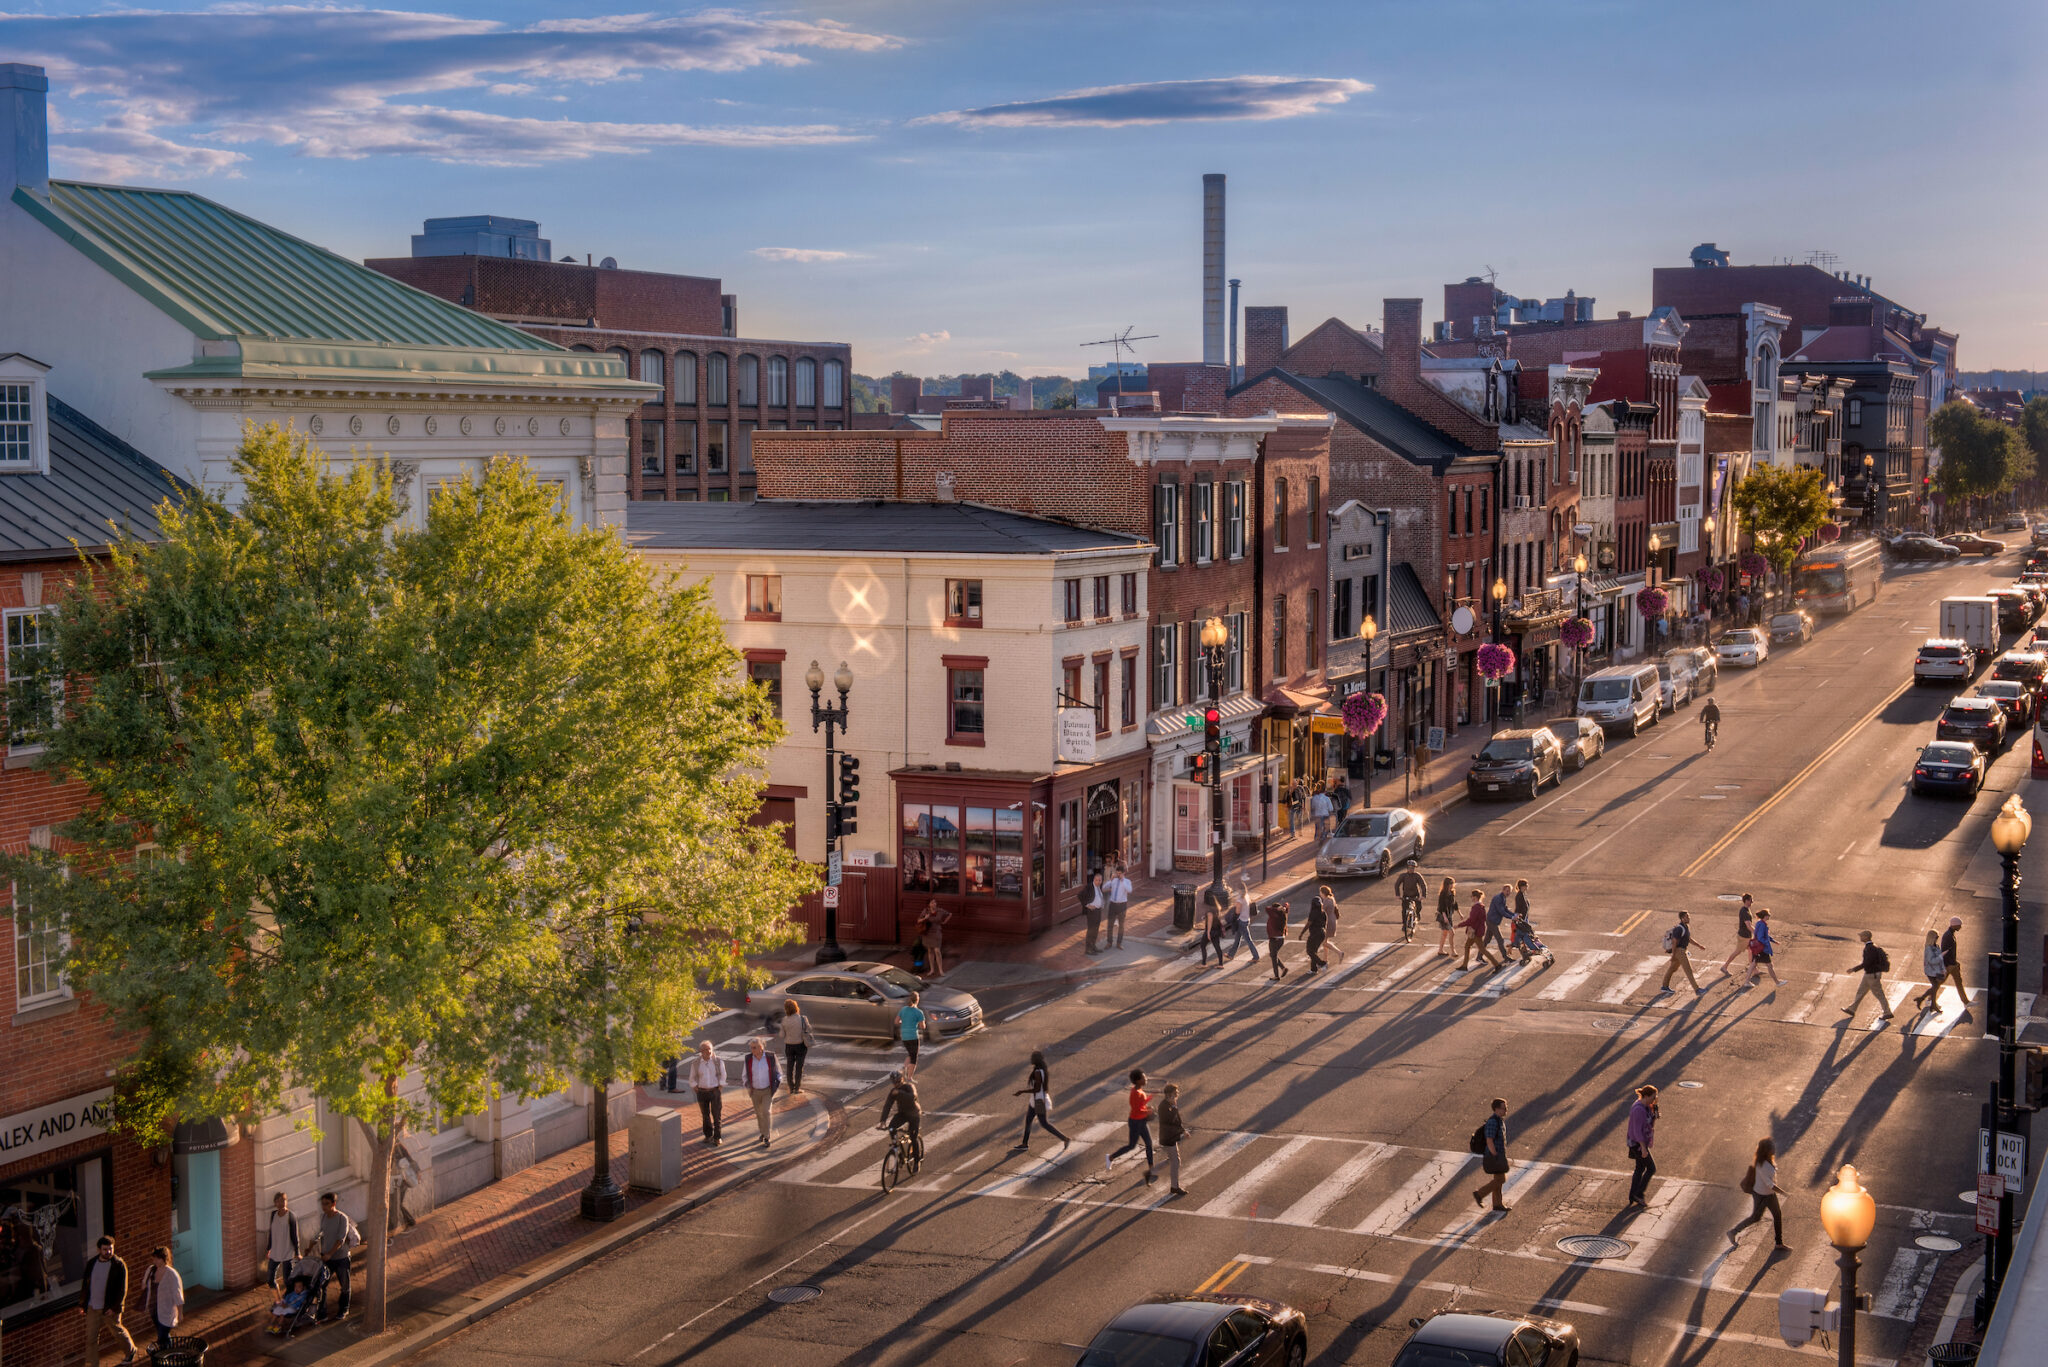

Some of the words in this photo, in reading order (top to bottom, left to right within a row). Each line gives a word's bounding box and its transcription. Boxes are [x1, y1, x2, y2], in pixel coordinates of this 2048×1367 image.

[38, 1111, 76, 1140] AND
[189, 1143, 217, 1151] POTOMAC
[2002, 1138, 2021, 1153] NOT
